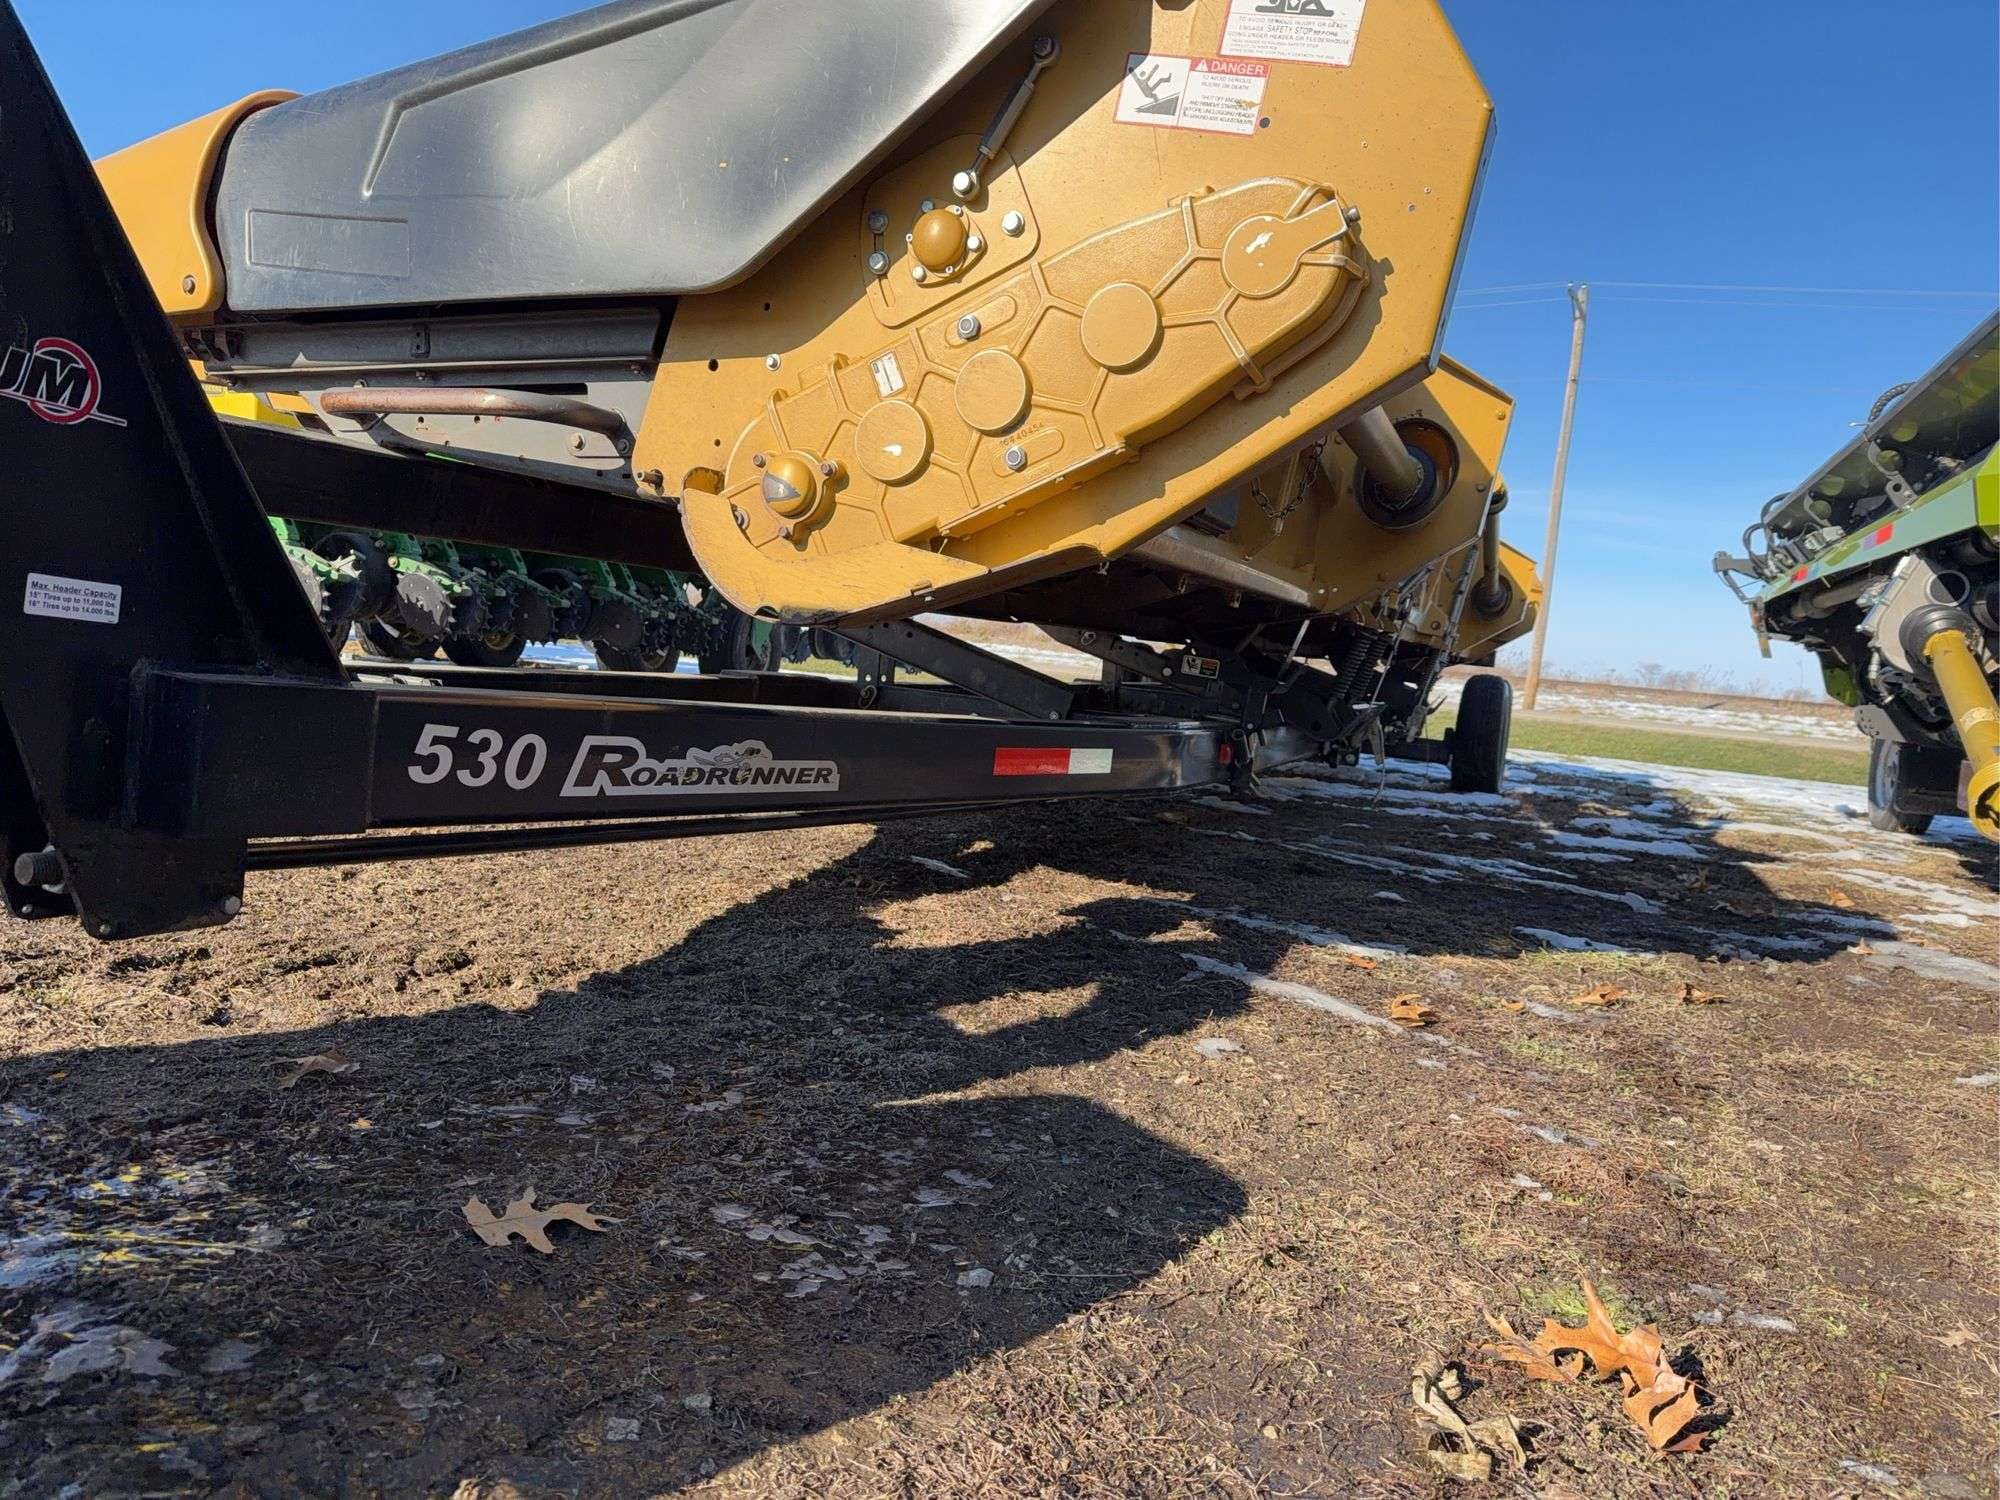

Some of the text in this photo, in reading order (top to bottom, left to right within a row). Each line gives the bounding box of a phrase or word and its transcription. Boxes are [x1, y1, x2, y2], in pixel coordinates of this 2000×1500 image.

[1266, 24, 1293, 34] SAFETY
[1294, 26, 1314, 35] STOP
[1211, 61, 1264, 74] DANGER
[31, 581, 117, 600] Max. Header Capacity
[44, 593, 61, 601] Tires
[42, 601, 60, 609] Tires
[407, 723, 548, 790] 530
